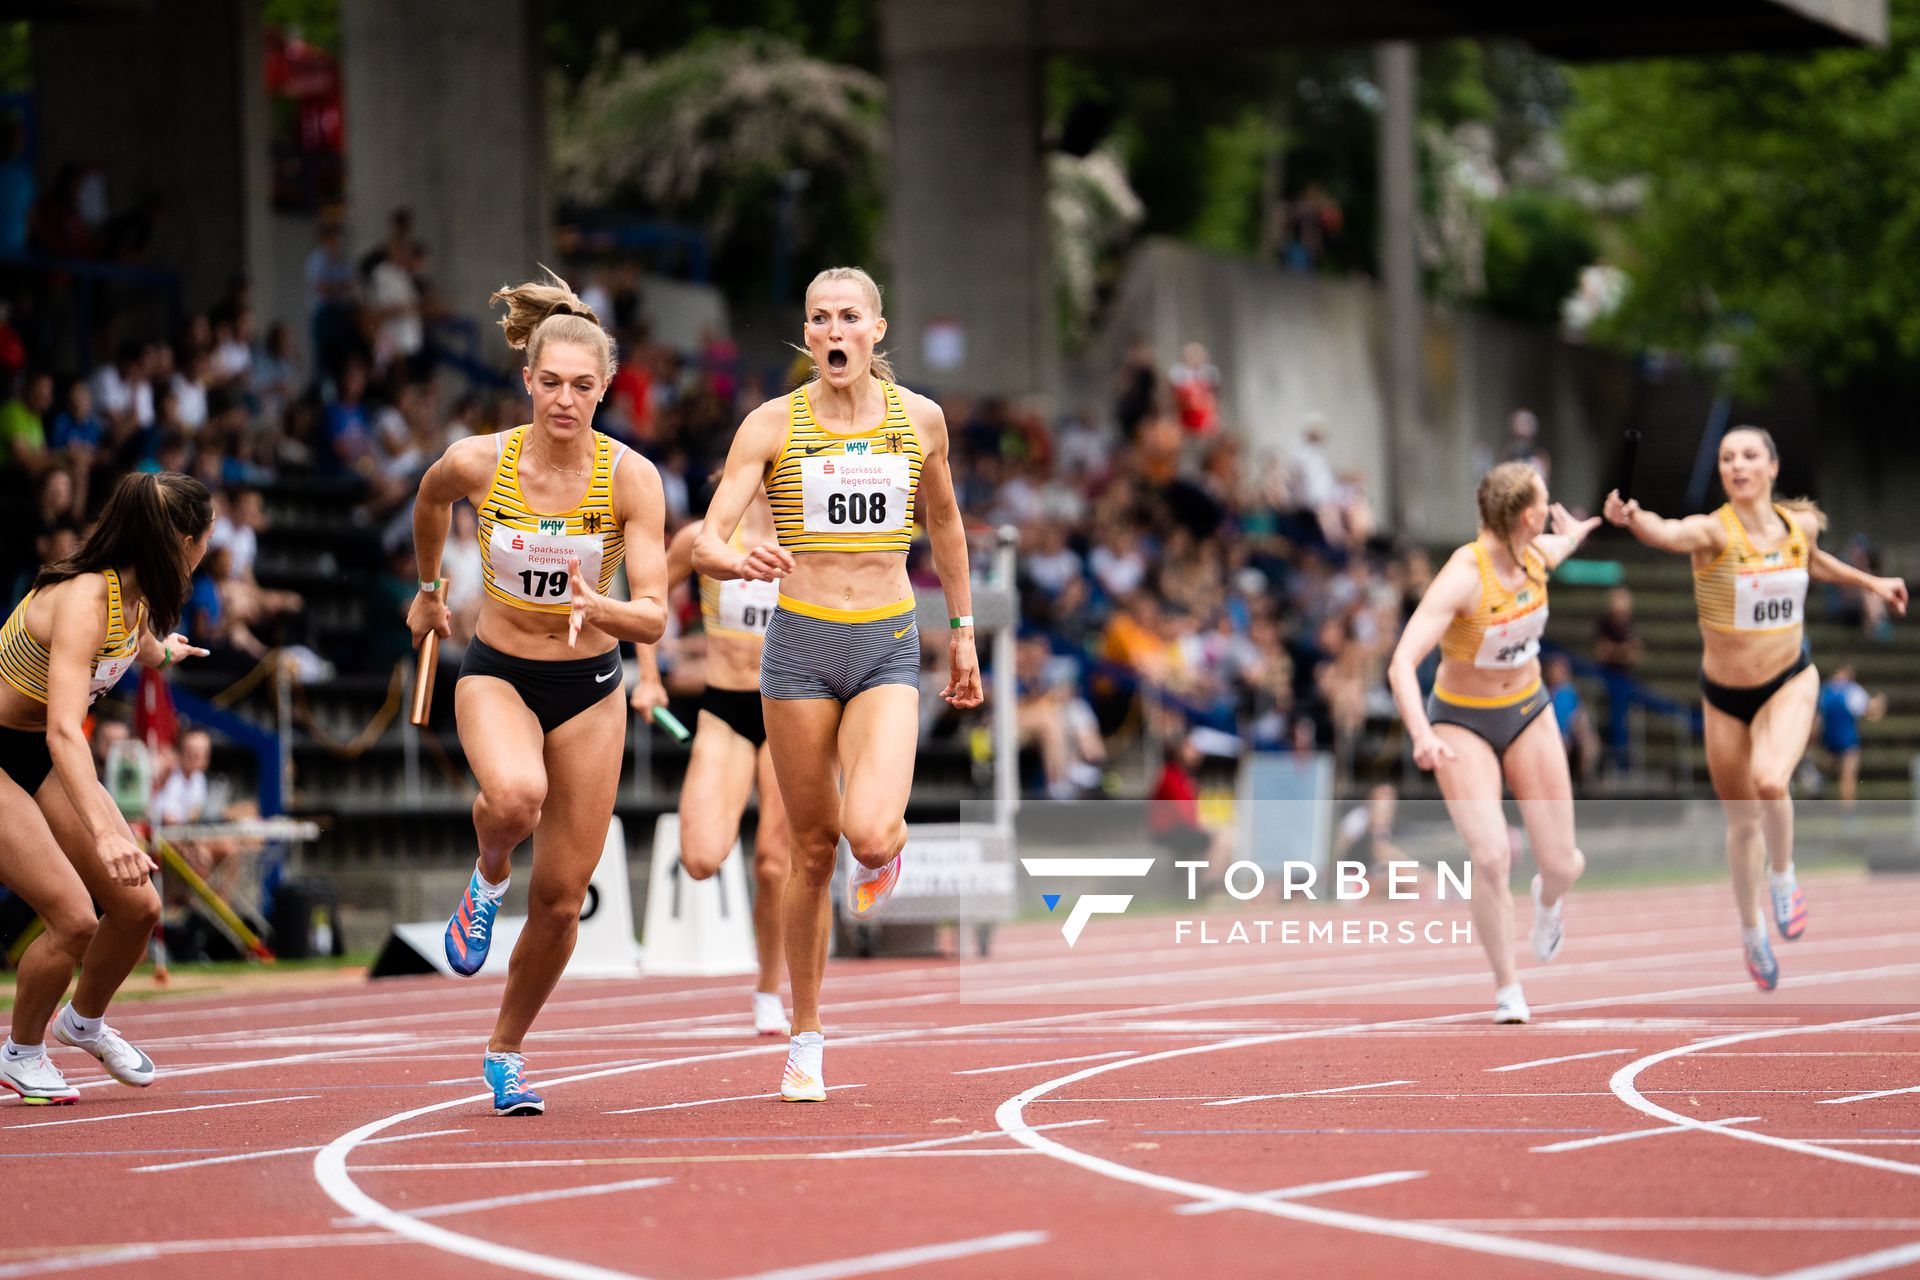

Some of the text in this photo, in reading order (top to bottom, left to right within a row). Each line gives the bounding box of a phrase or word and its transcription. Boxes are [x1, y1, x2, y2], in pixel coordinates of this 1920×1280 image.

[840, 466, 882, 476] Sparkasse
[841, 477, 892, 487] Regensburg
[828, 492, 887, 525] 608
[528, 544, 574, 556] Sparkasse
[528, 554, 582, 567] Regensb
[518, 569, 569, 598] 179
[1753, 597, 1793, 624] 609
